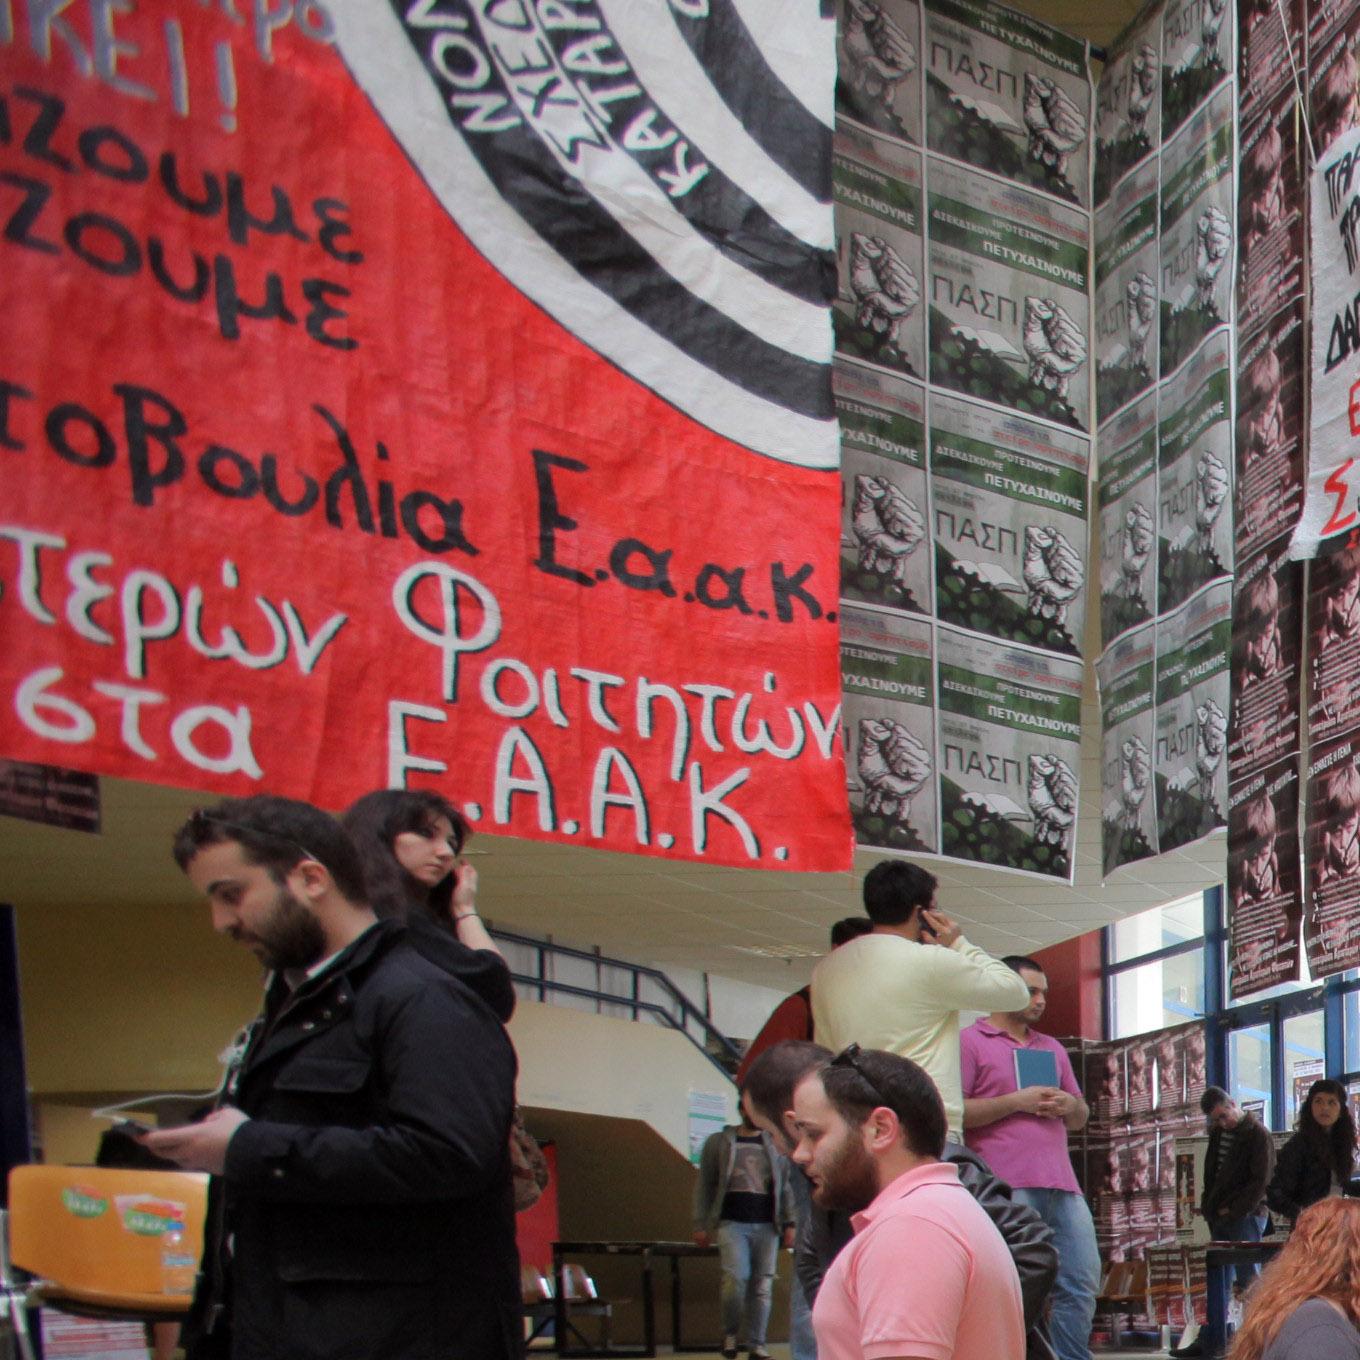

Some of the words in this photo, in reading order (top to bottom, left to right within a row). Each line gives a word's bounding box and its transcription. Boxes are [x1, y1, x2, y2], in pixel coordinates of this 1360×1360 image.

[931, 41, 1018, 99] ΠΑΣΠ
[983, 240, 1084, 286] ΠΕΤΥΧΑΙΝΟΥΜΕ
[933, 274, 1018, 326] ΠΑΣΠ
[985, 472, 1083, 512] ΠΕΤΥΧΑΙΝΟΥΜΕ
[935, 509, 1018, 556] ΠΑΣΠ
[987, 705, 1081, 736] ΠΕΤΥΧΑΙΝΟΥΜΕ
[944, 743, 1022, 786] ΠΑΣΠ
